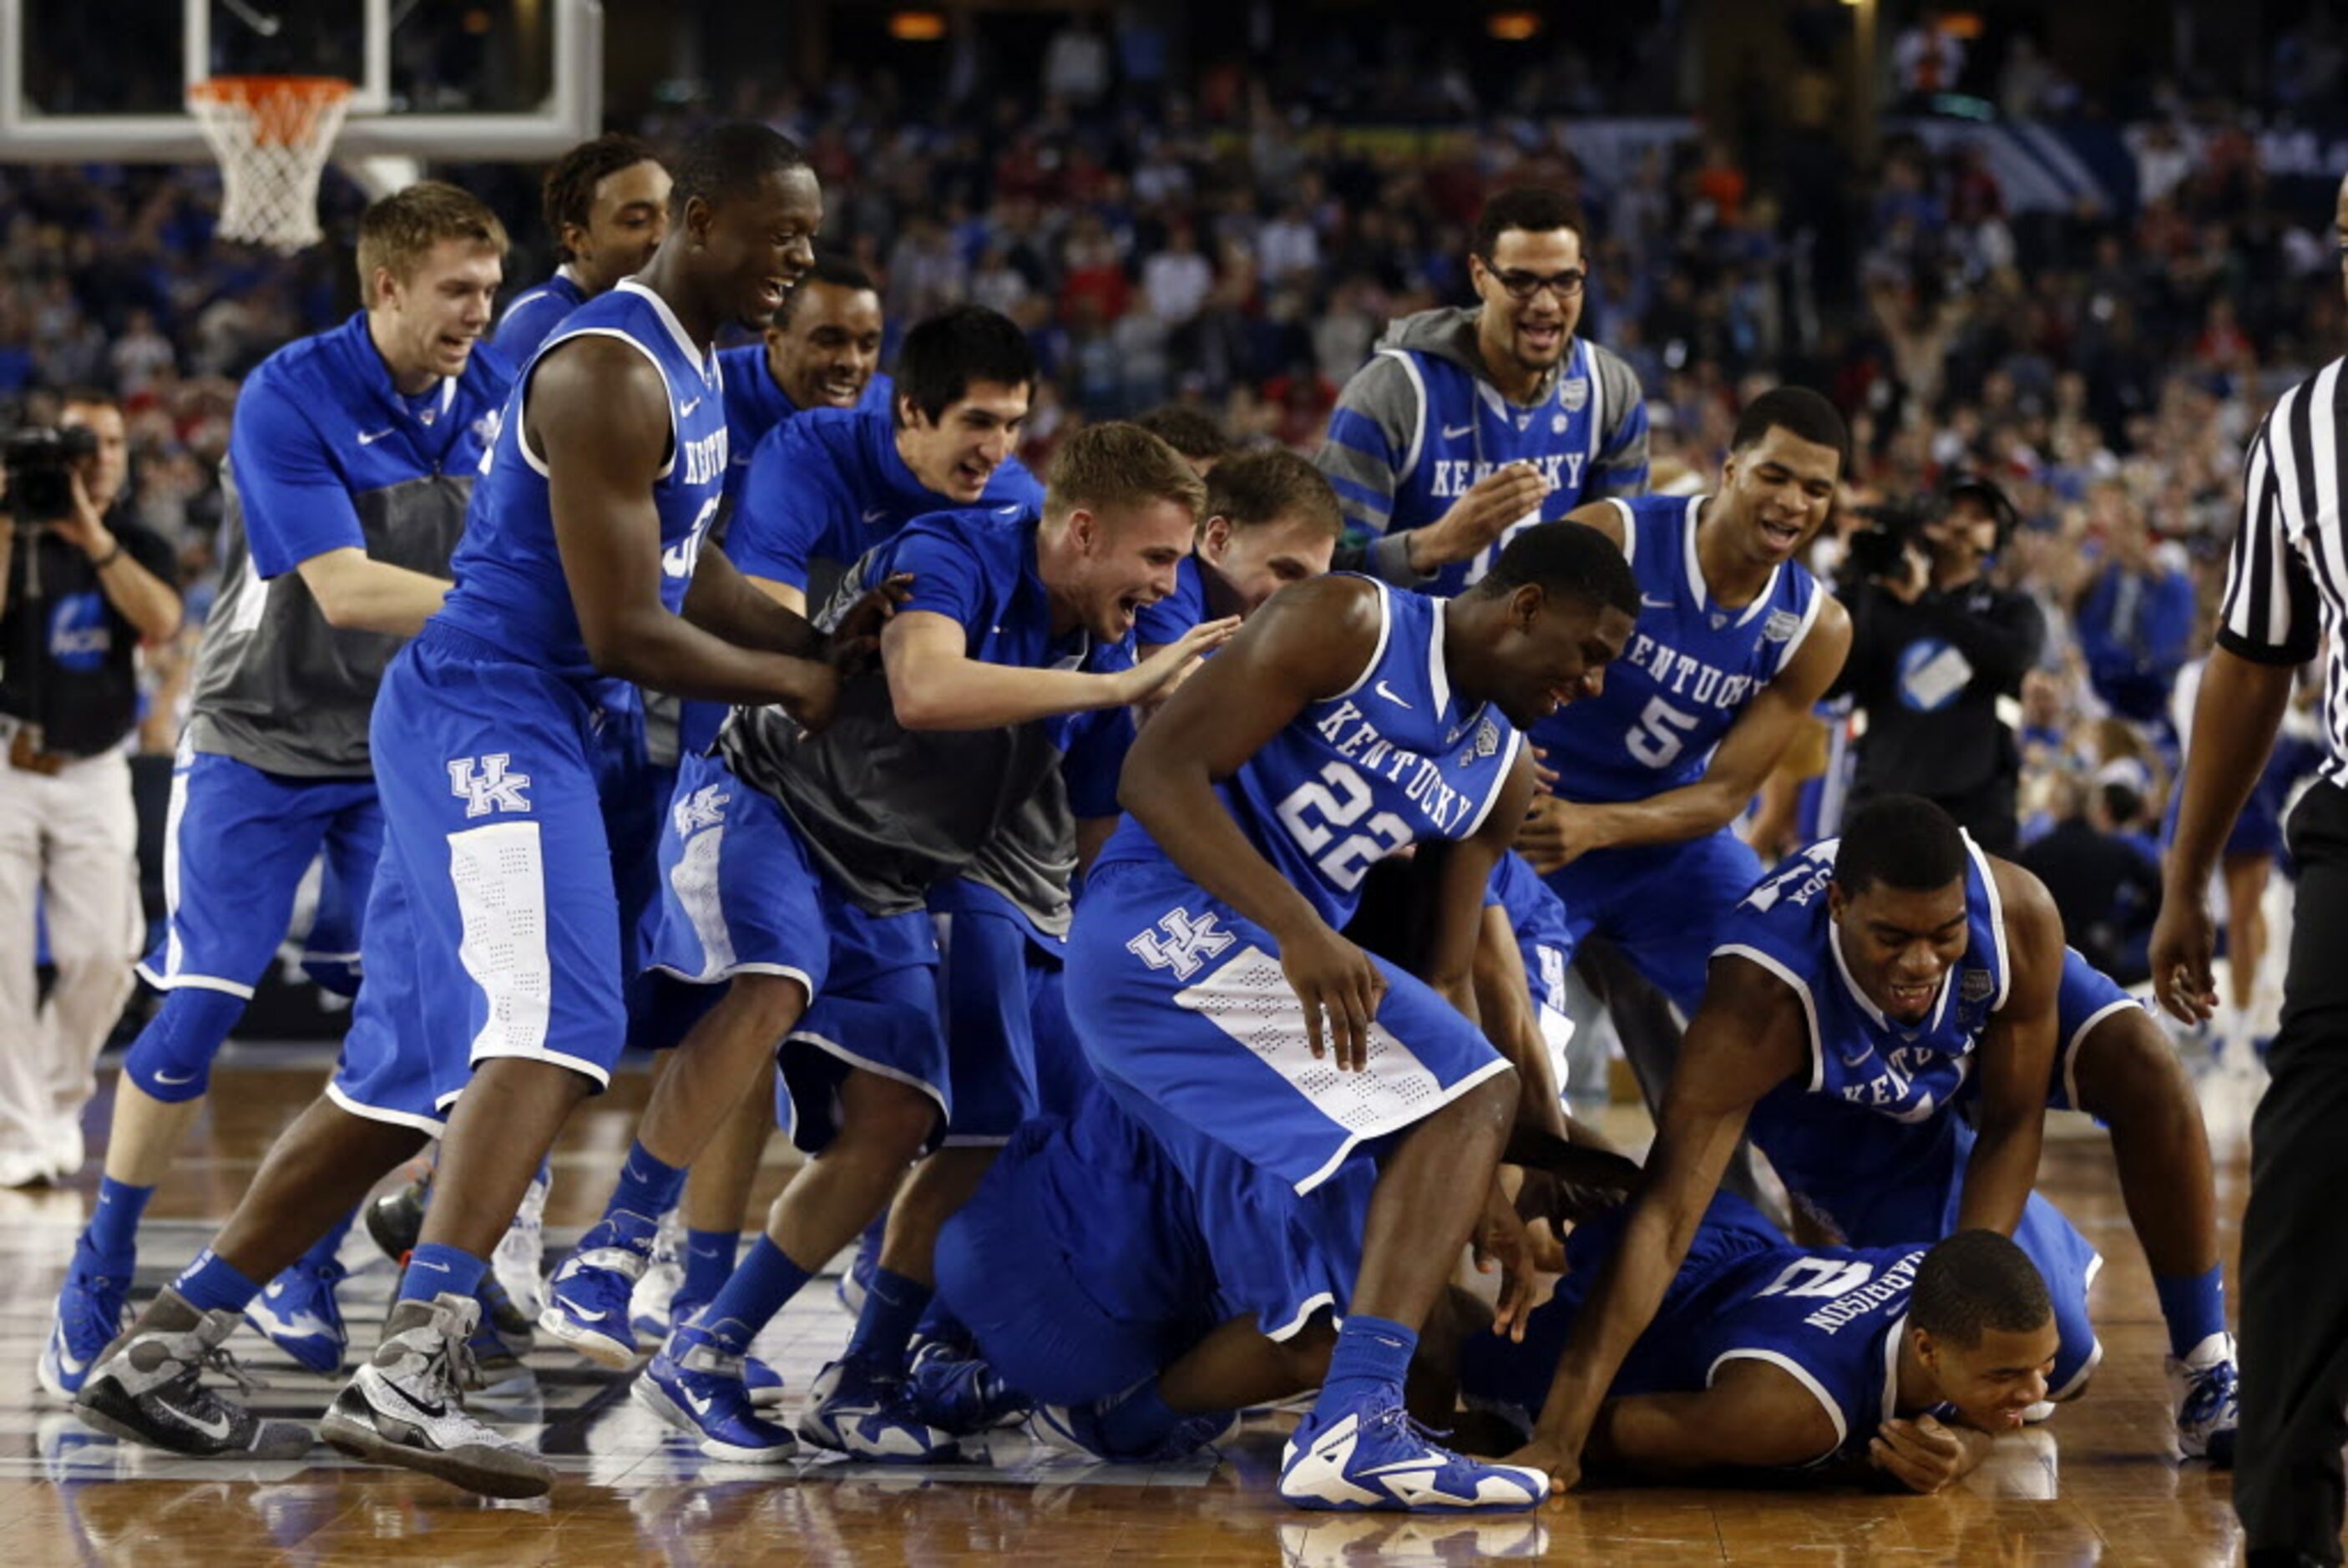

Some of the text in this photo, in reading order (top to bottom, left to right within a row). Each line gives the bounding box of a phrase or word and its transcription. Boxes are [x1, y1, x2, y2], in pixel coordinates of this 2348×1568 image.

[1430, 452, 1585, 497] KENKY
[1317, 700, 1472, 835] KENTUCKY
[1626, 695, 1699, 768] 5
[447, 752, 531, 819] UK
[1276, 760, 1414, 892] 22
[1126, 907, 1237, 989] UK
[1751, 1257, 1874, 1298] 2
